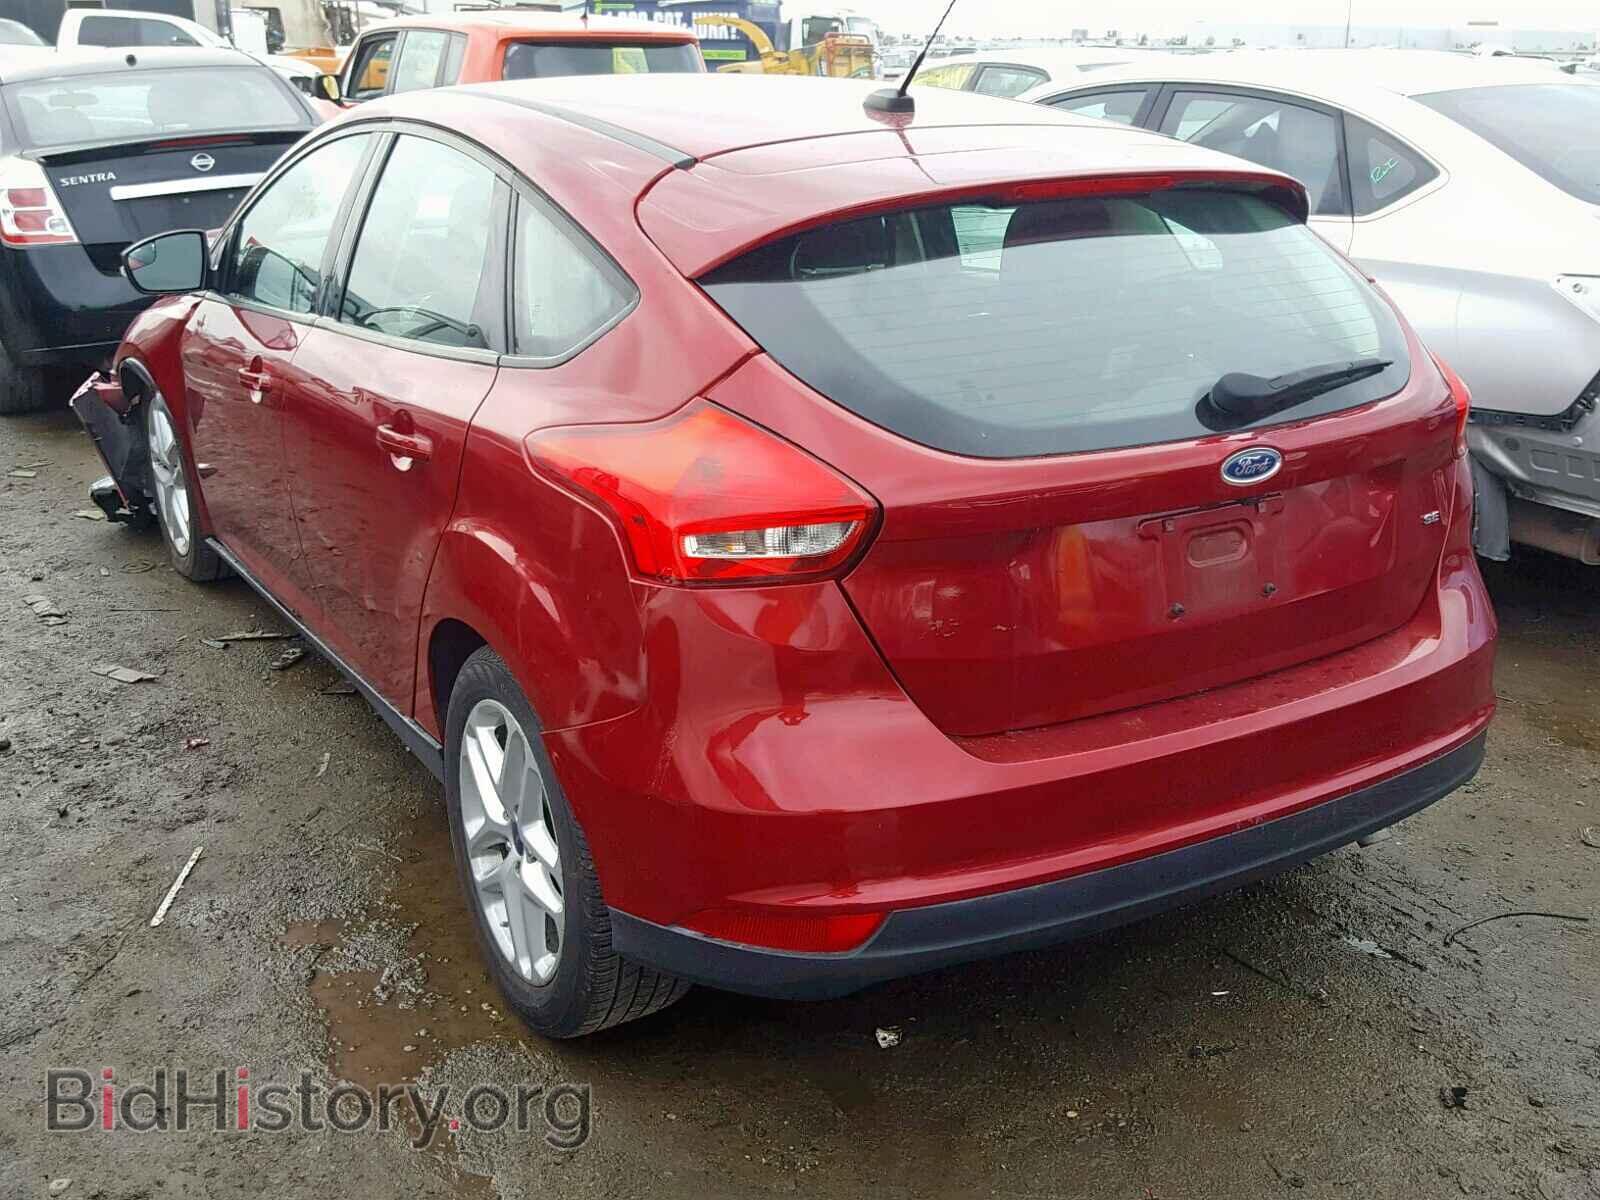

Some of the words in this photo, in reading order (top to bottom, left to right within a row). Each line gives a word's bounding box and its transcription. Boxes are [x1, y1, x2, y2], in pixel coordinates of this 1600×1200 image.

[60, 171, 117, 187] SENTRA
[1234, 455, 1270, 476] Ford
[1423, 510, 1440, 525] SE
